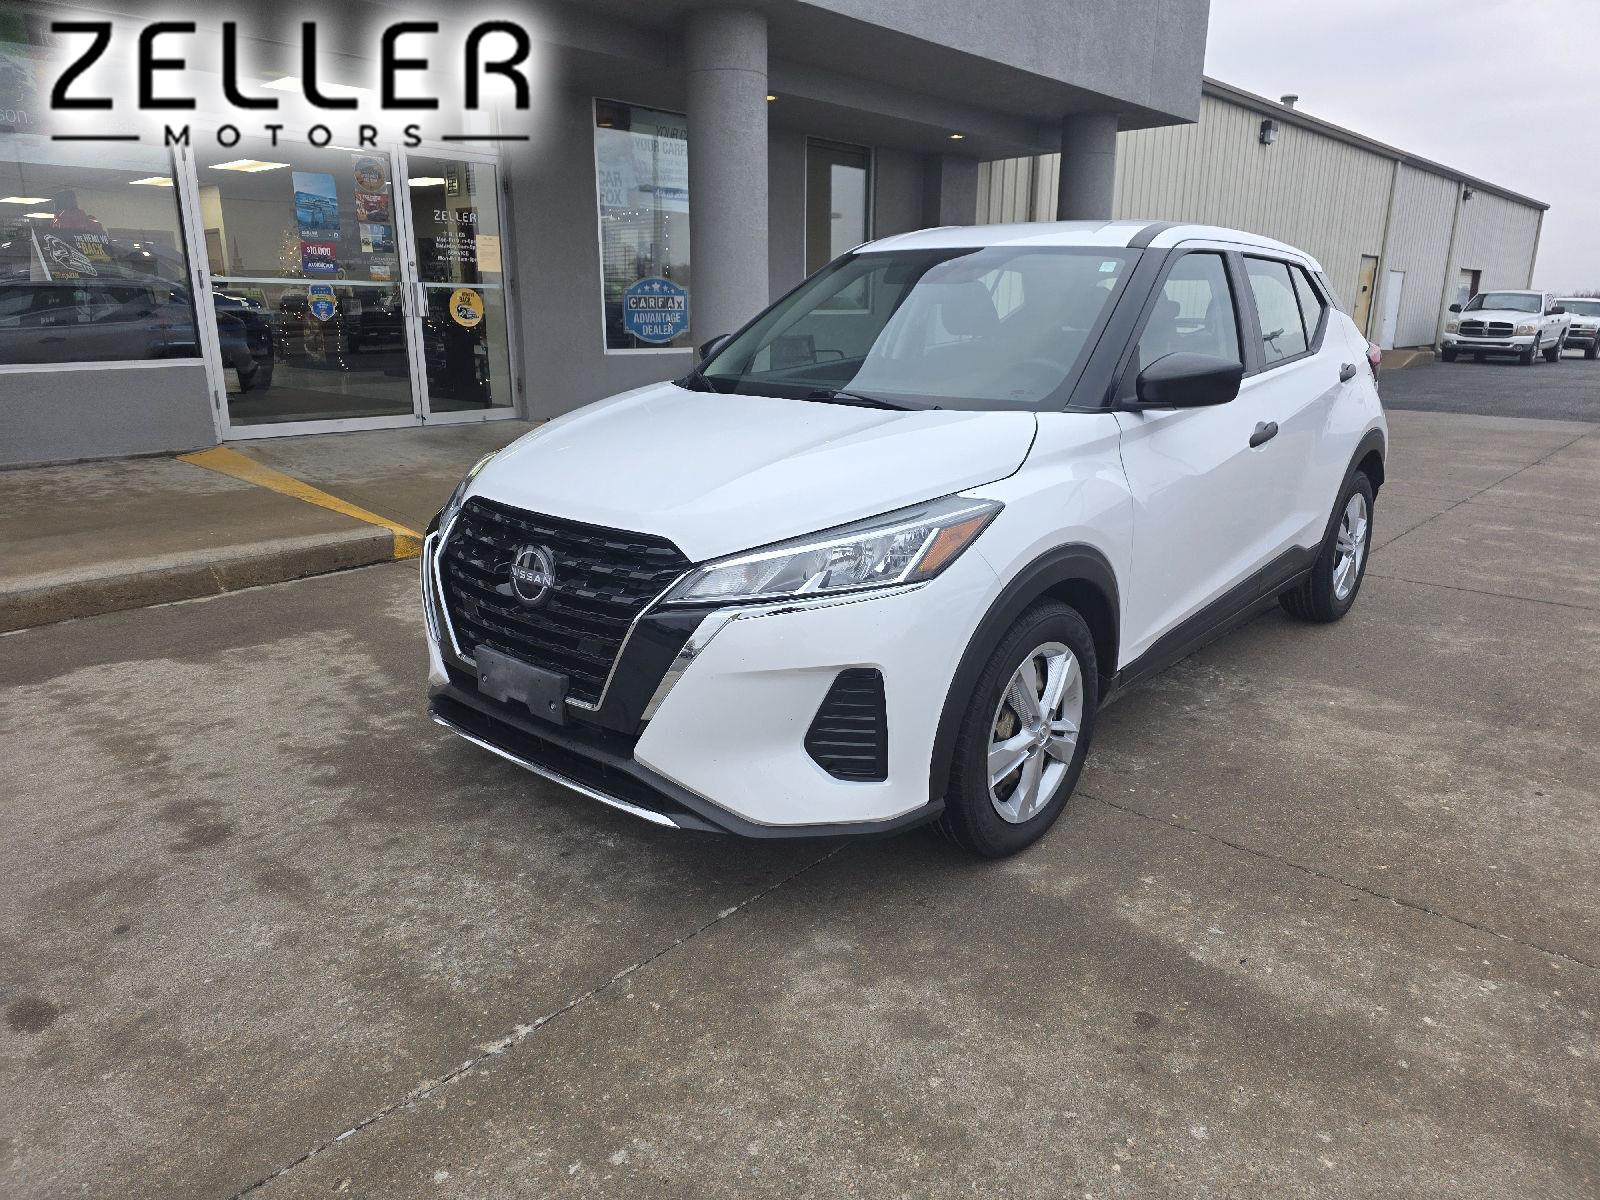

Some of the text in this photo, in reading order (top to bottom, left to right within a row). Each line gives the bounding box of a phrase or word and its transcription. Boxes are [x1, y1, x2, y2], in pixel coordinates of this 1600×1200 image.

[656, 125, 678, 139] YOUR
[633, 138, 687, 156] YOUR CARF
[433, 210, 478, 222] ZELLER
[629, 297, 683, 309] CARFAX
[634, 312, 681, 323] ADVANTAGE
[642, 324, 674, 336] DEALER
[511, 565, 551, 585] NISSAN
